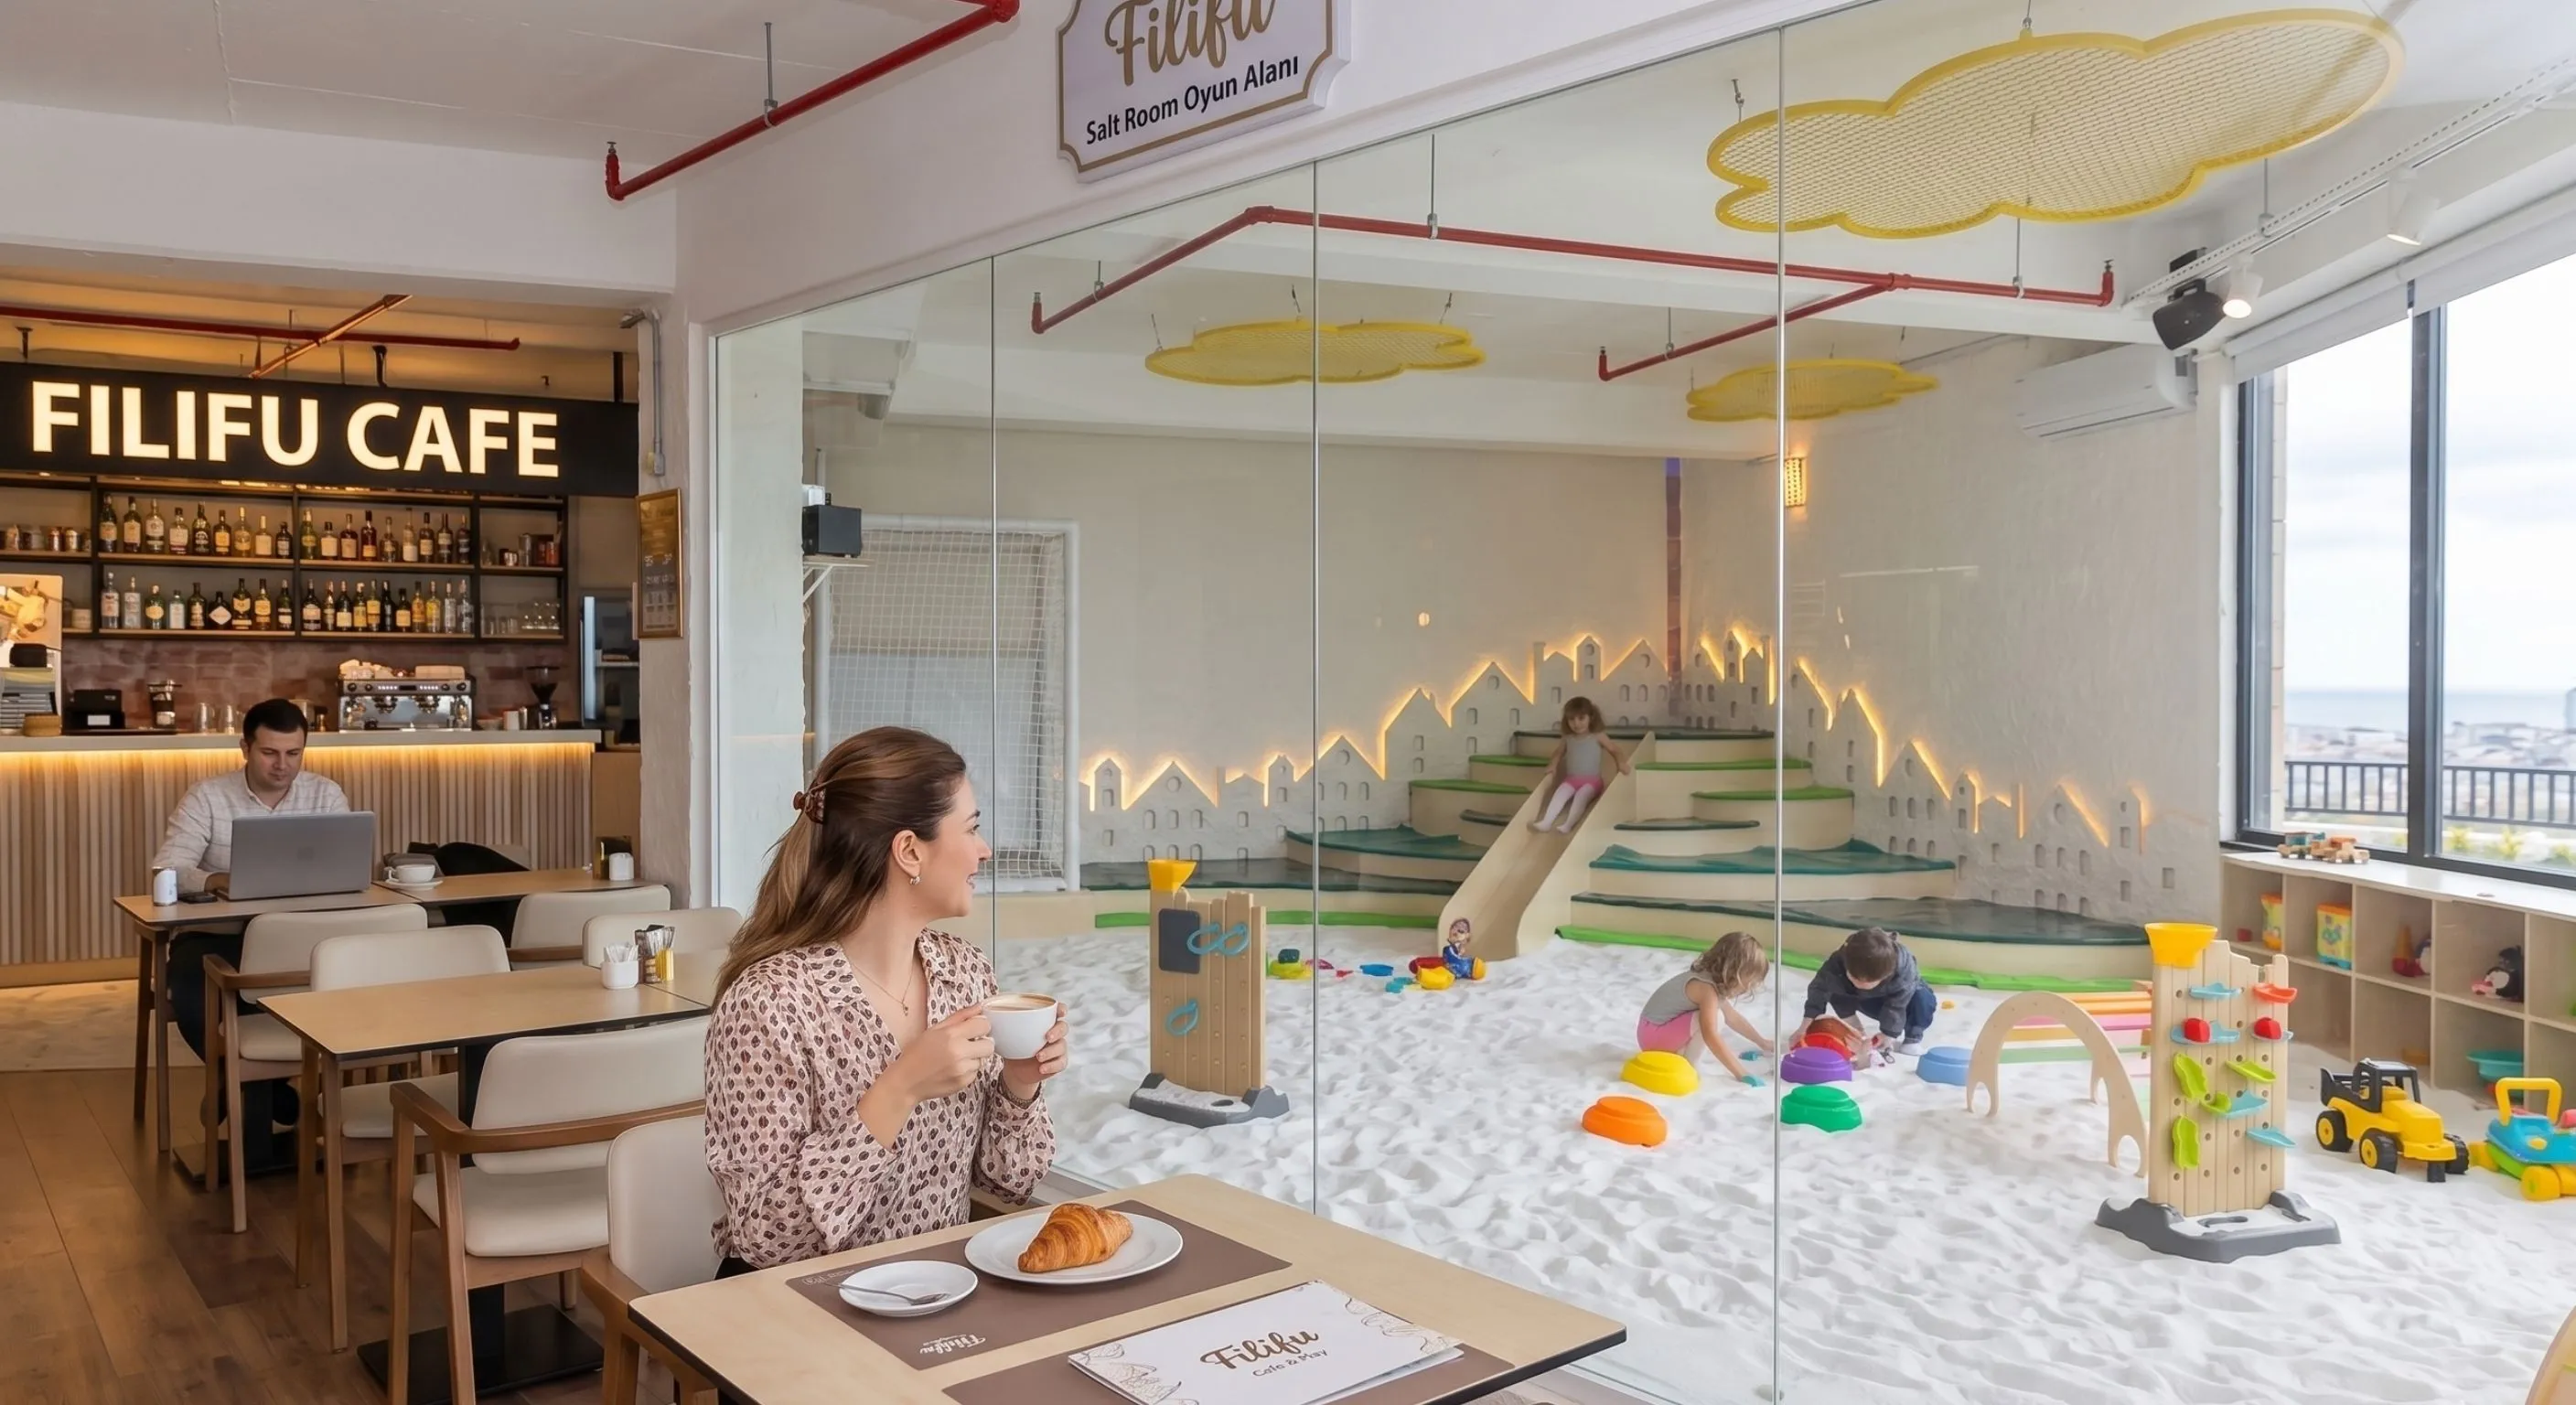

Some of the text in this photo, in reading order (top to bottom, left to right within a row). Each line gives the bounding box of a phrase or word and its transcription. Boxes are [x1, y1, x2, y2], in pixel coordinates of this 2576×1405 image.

[1086, 56, 1299, 145] Salt Room Oyun Alanı
[31, 381, 560, 478] FILIFU CAFE
[1199, 1331, 1319, 1369] Filifu
